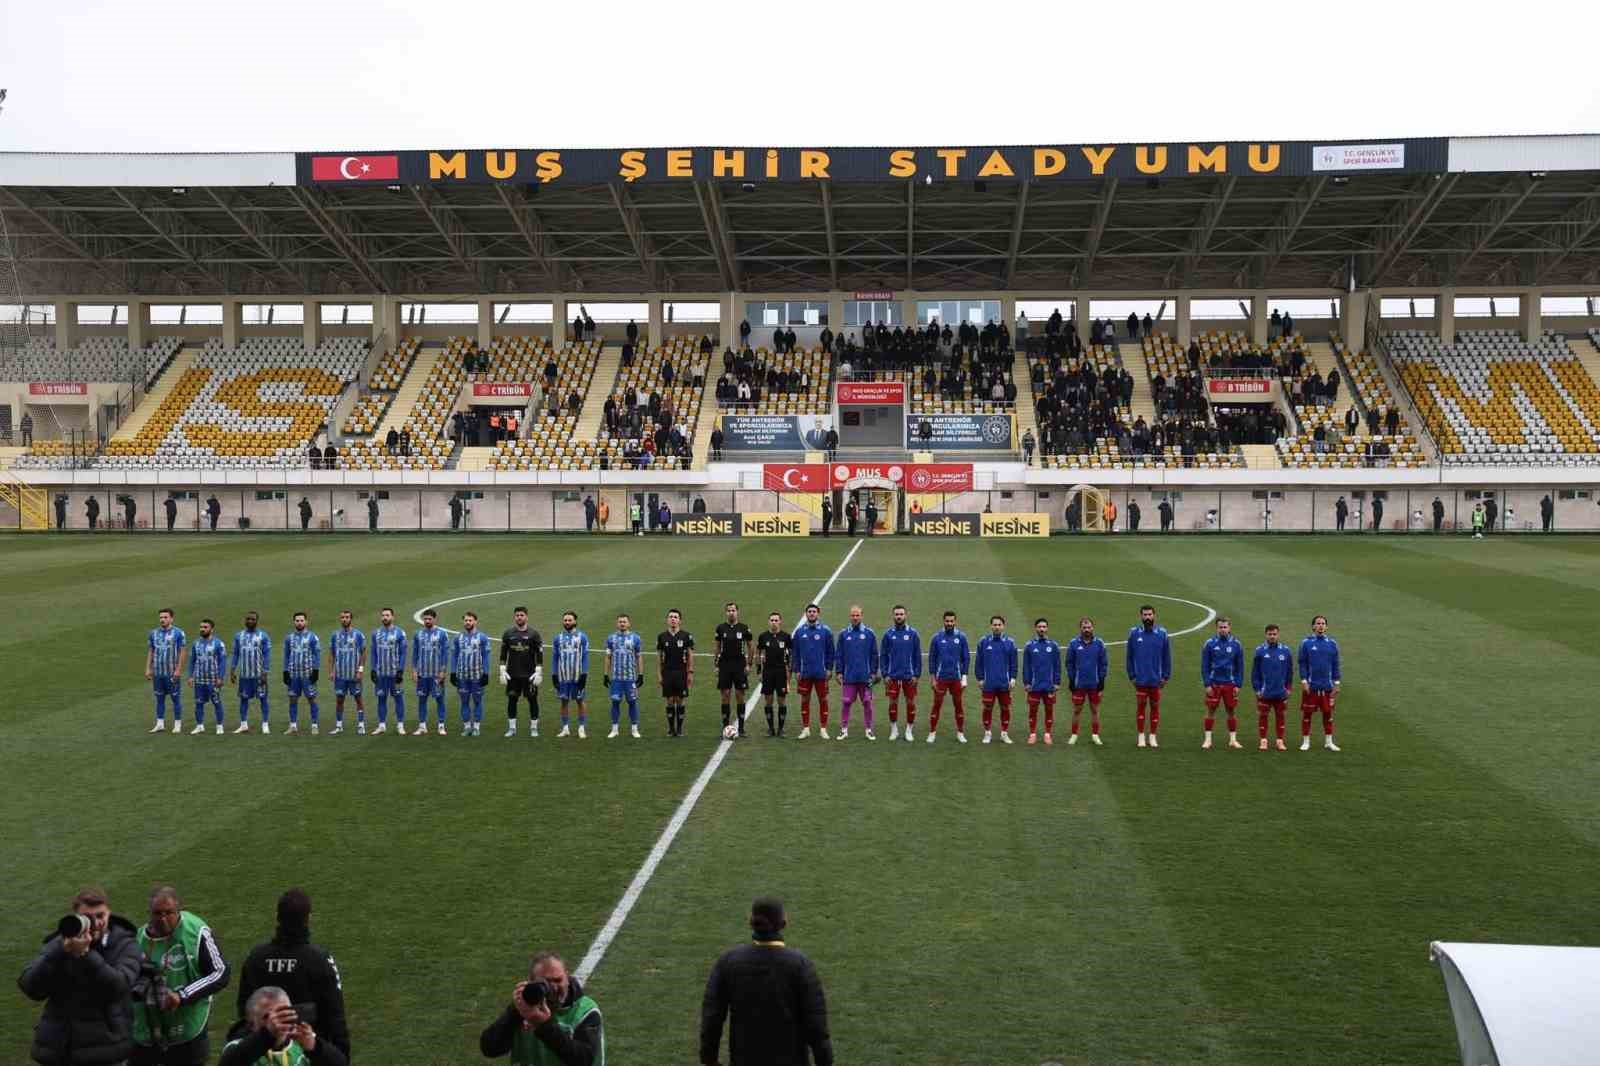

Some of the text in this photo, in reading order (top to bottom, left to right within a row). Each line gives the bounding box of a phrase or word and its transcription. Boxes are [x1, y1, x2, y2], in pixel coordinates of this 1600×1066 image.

[429, 144, 1280, 183] MUŞ ŞEHİR STADYUMU
[491, 384, 525, 394] C TRİBÜN
[1234, 382, 1264, 392] TRİBÜN
[265, 958, 297, 972] TFF
